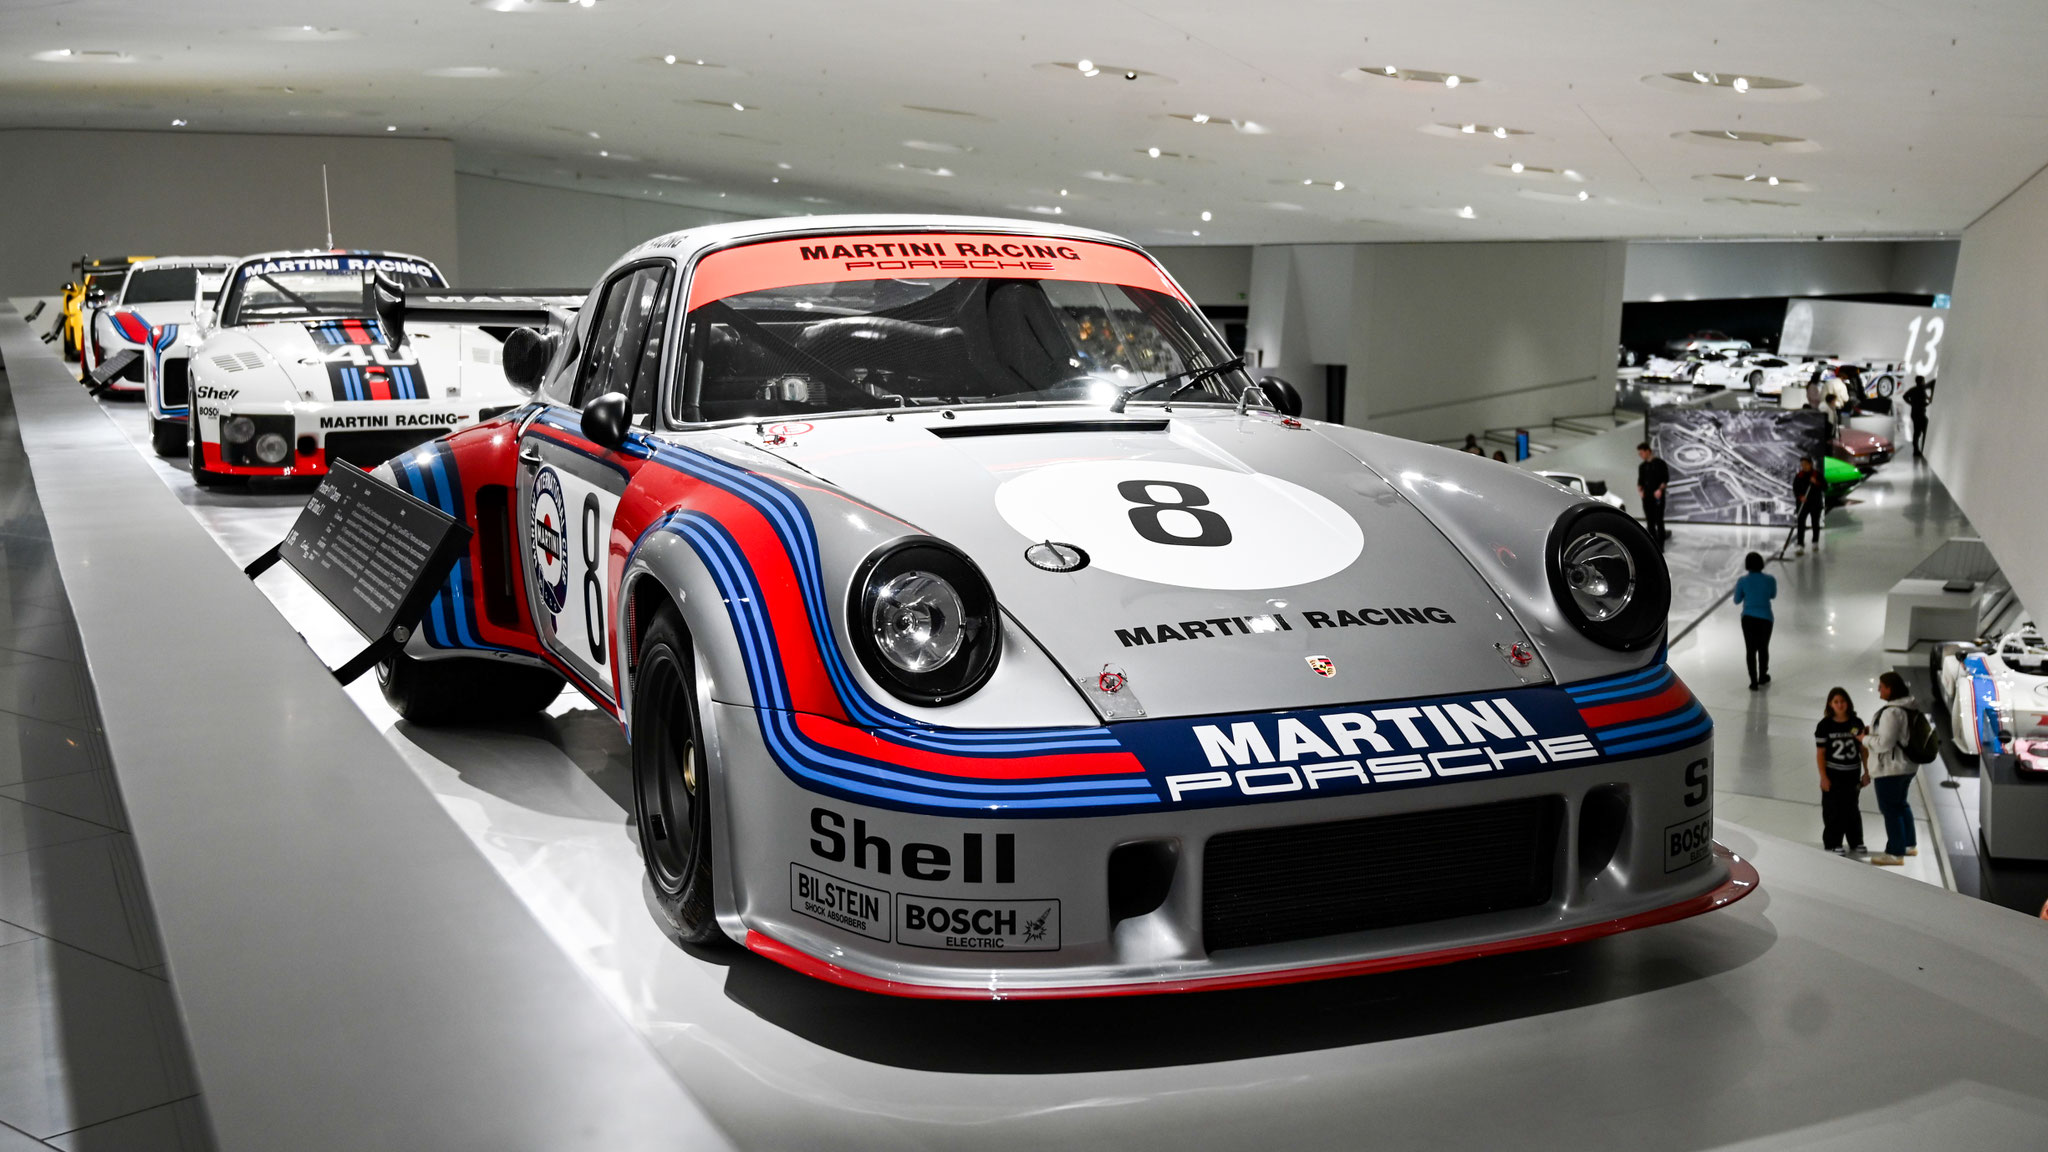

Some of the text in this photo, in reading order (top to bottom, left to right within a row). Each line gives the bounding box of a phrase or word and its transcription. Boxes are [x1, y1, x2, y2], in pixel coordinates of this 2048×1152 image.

[799, 242, 1081, 261] MARTINI RACING
[845, 260, 1056, 272] PORSCHE
[244, 258, 433, 278] MARTINI RACING
[1904, 316, 1945, 377] 13
[197, 385, 240, 400] Shell
[320, 413, 458, 429] MARTINI RACING
[1117, 479, 1233, 547] 8
[536, 523, 560, 557] MARTINI
[582, 491, 607, 666] 8
[1301, 606, 1457, 629] RACING
[1192, 697, 1538, 768] MARTINI
[1831, 739, 1858, 760] 23
[1164, 733, 1600, 802] PORSCHE
[810, 807, 1015, 883] Shell
[798, 872, 880, 922] BILSTEIN
[804, 901, 867, 932] SHOCK ABSORBERS
[905, 903, 1017, 936] BOSCH
[945, 936, 1005, 949] ELECTRIC
